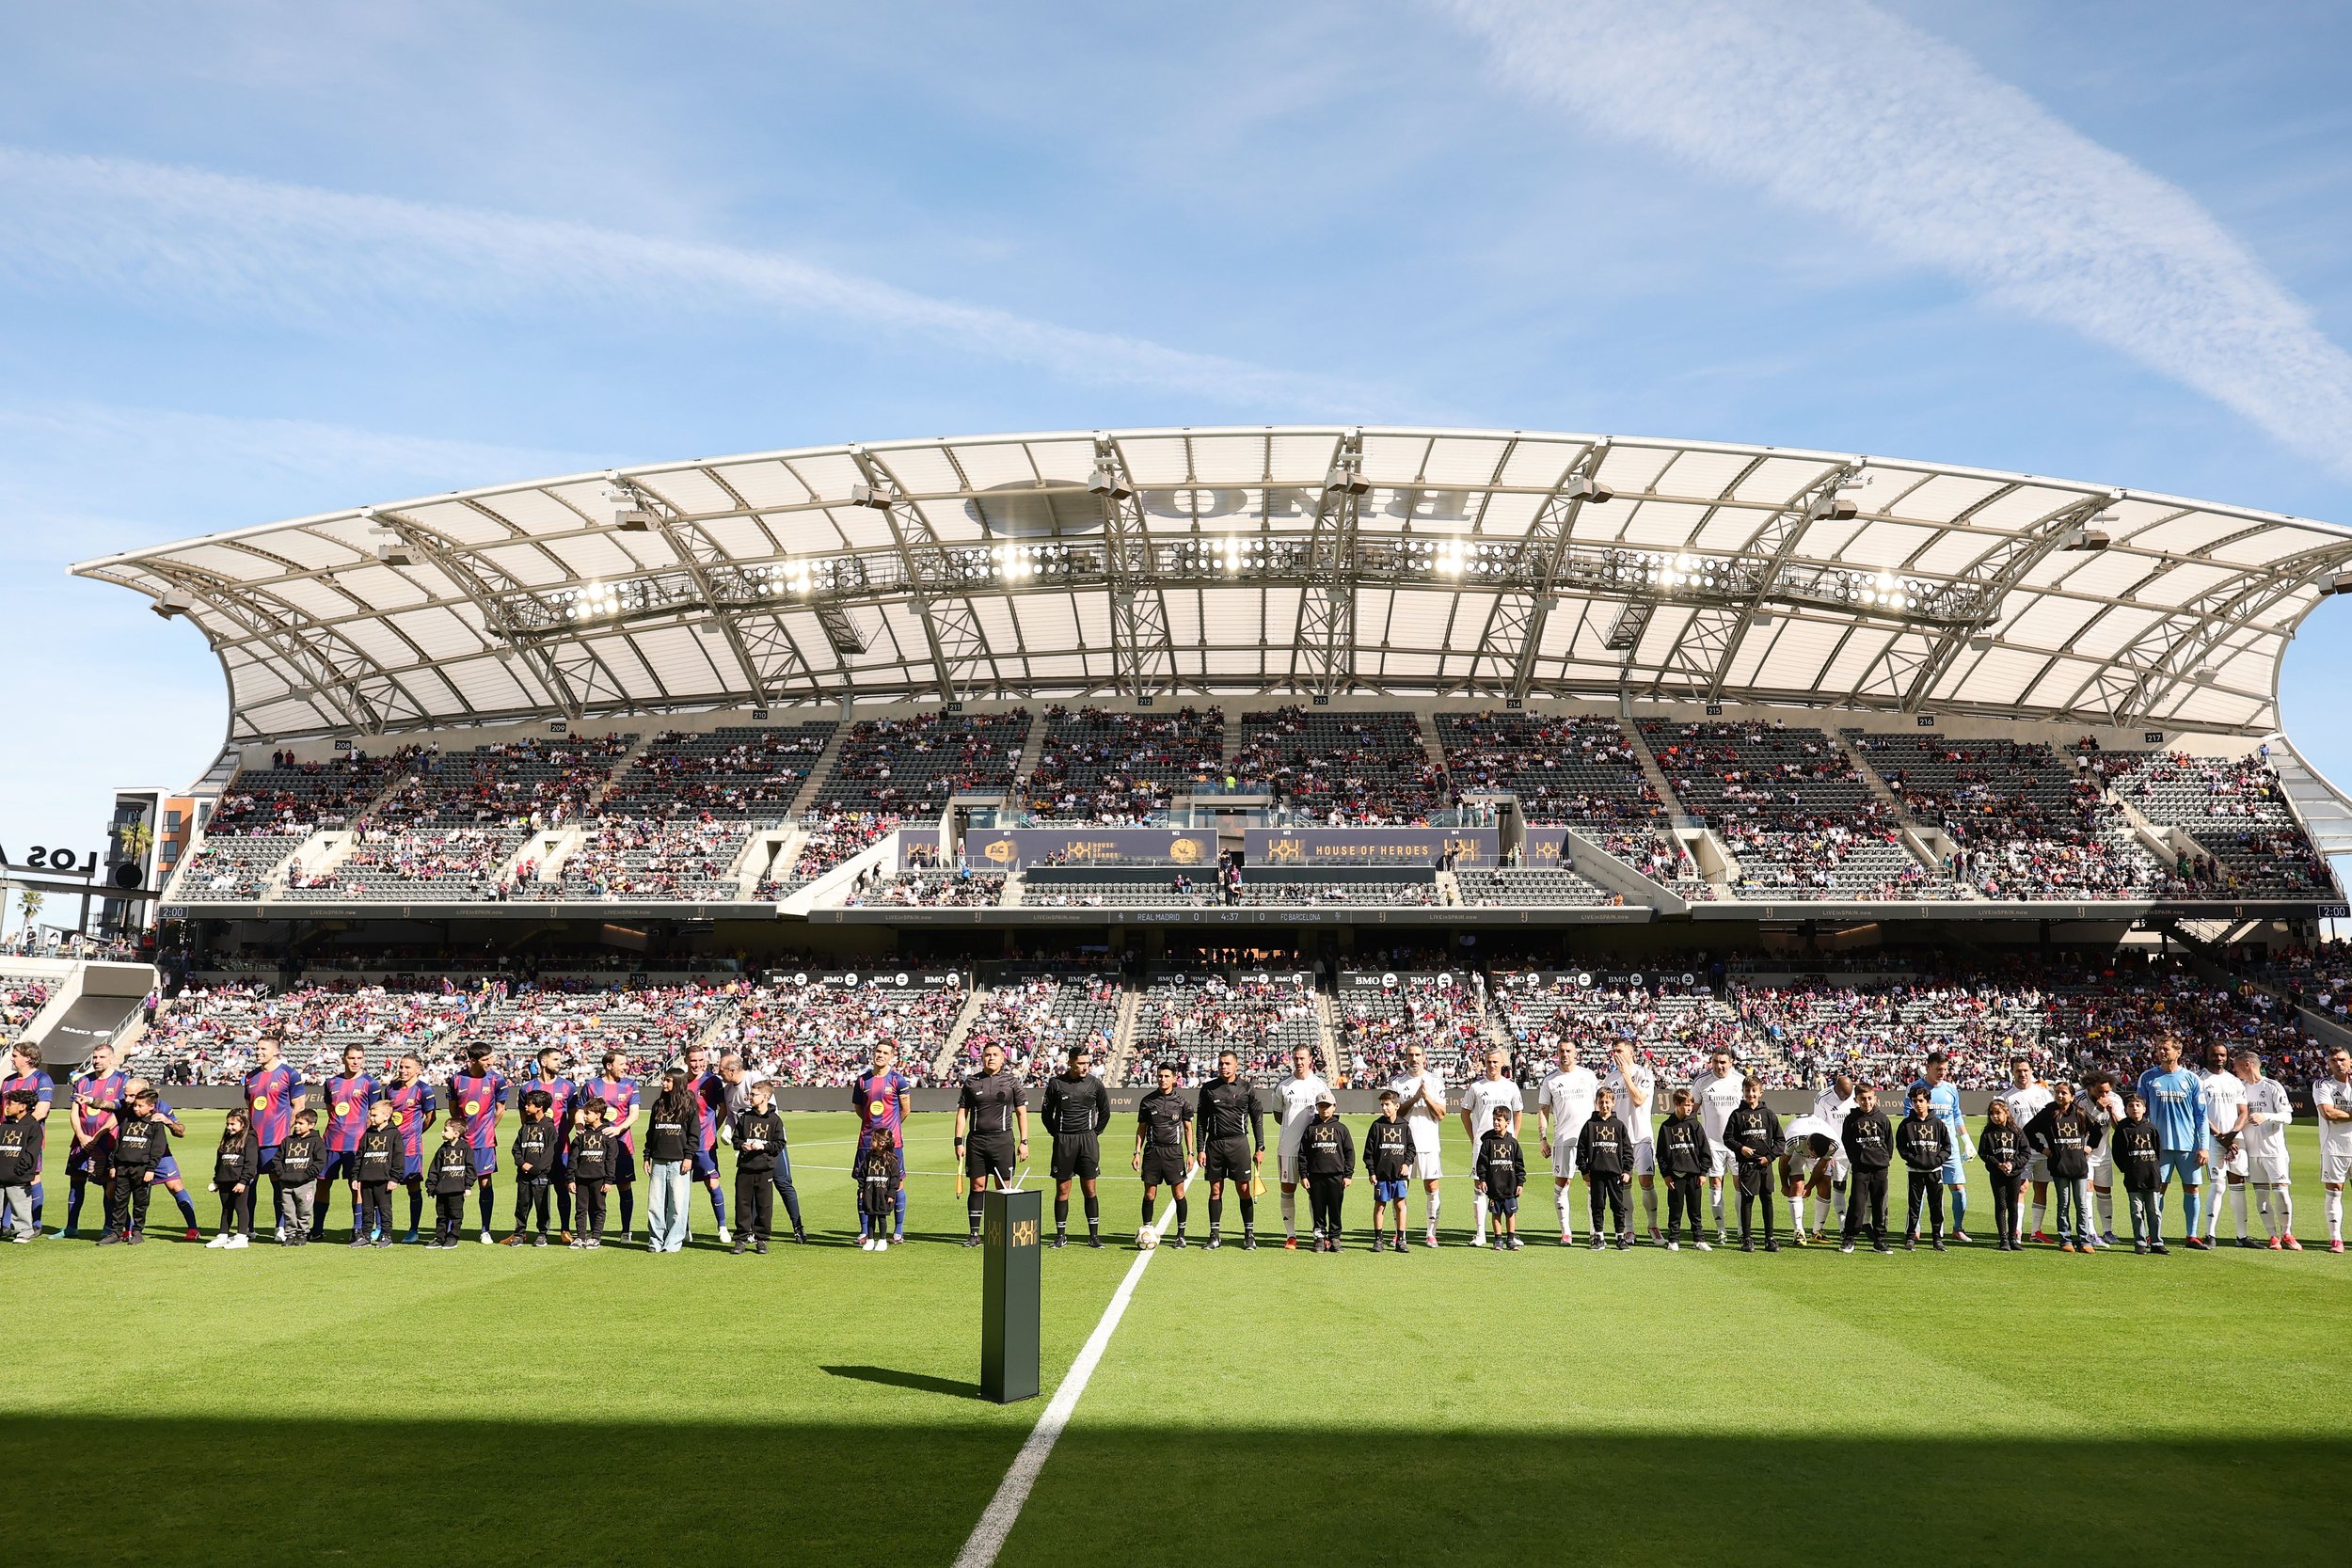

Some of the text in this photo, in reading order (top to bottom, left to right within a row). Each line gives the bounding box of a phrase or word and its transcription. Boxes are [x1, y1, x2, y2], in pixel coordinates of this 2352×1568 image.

[1919, 718, 1932, 726] 216
[336, 741, 351, 750] 208
[1316, 846, 1428, 855] HOUSE OF HEROES
[163, 908, 183, 917] 2:00
[2324, 907, 2345, 916] 2:00
[1220, 912, 1239, 921] 4:37
[1259, 912, 1264, 921] 0
[1355, 976, 1380, 985] BMO
[1410, 976, 1435, 985] BMO
[61, 1026, 90, 1035] BMO
